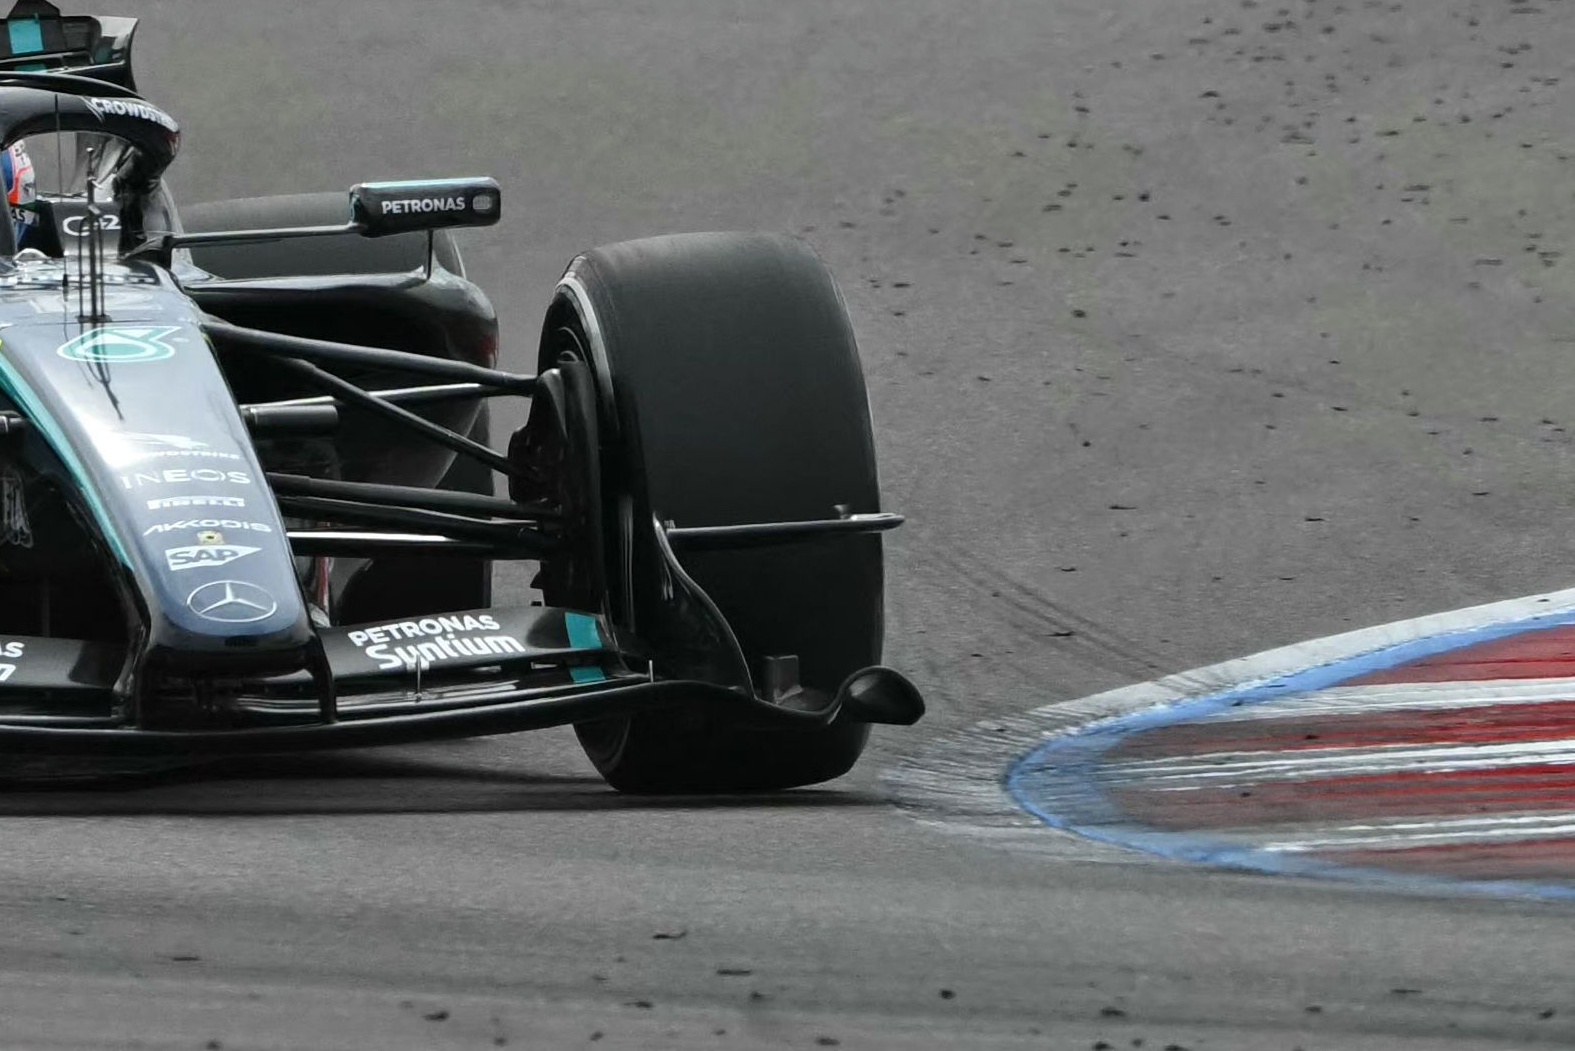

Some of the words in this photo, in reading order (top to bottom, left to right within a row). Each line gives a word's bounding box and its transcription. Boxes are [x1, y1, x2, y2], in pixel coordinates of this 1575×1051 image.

[381, 197, 466, 214] PETRONAS
[121, 468, 251, 490] INEOS
[142, 519, 272, 537] AKKODIS
[169, 549, 240, 566] SAP
[347, 615, 501, 647] PETRONAS
[365, 633, 526, 671] Syntium
